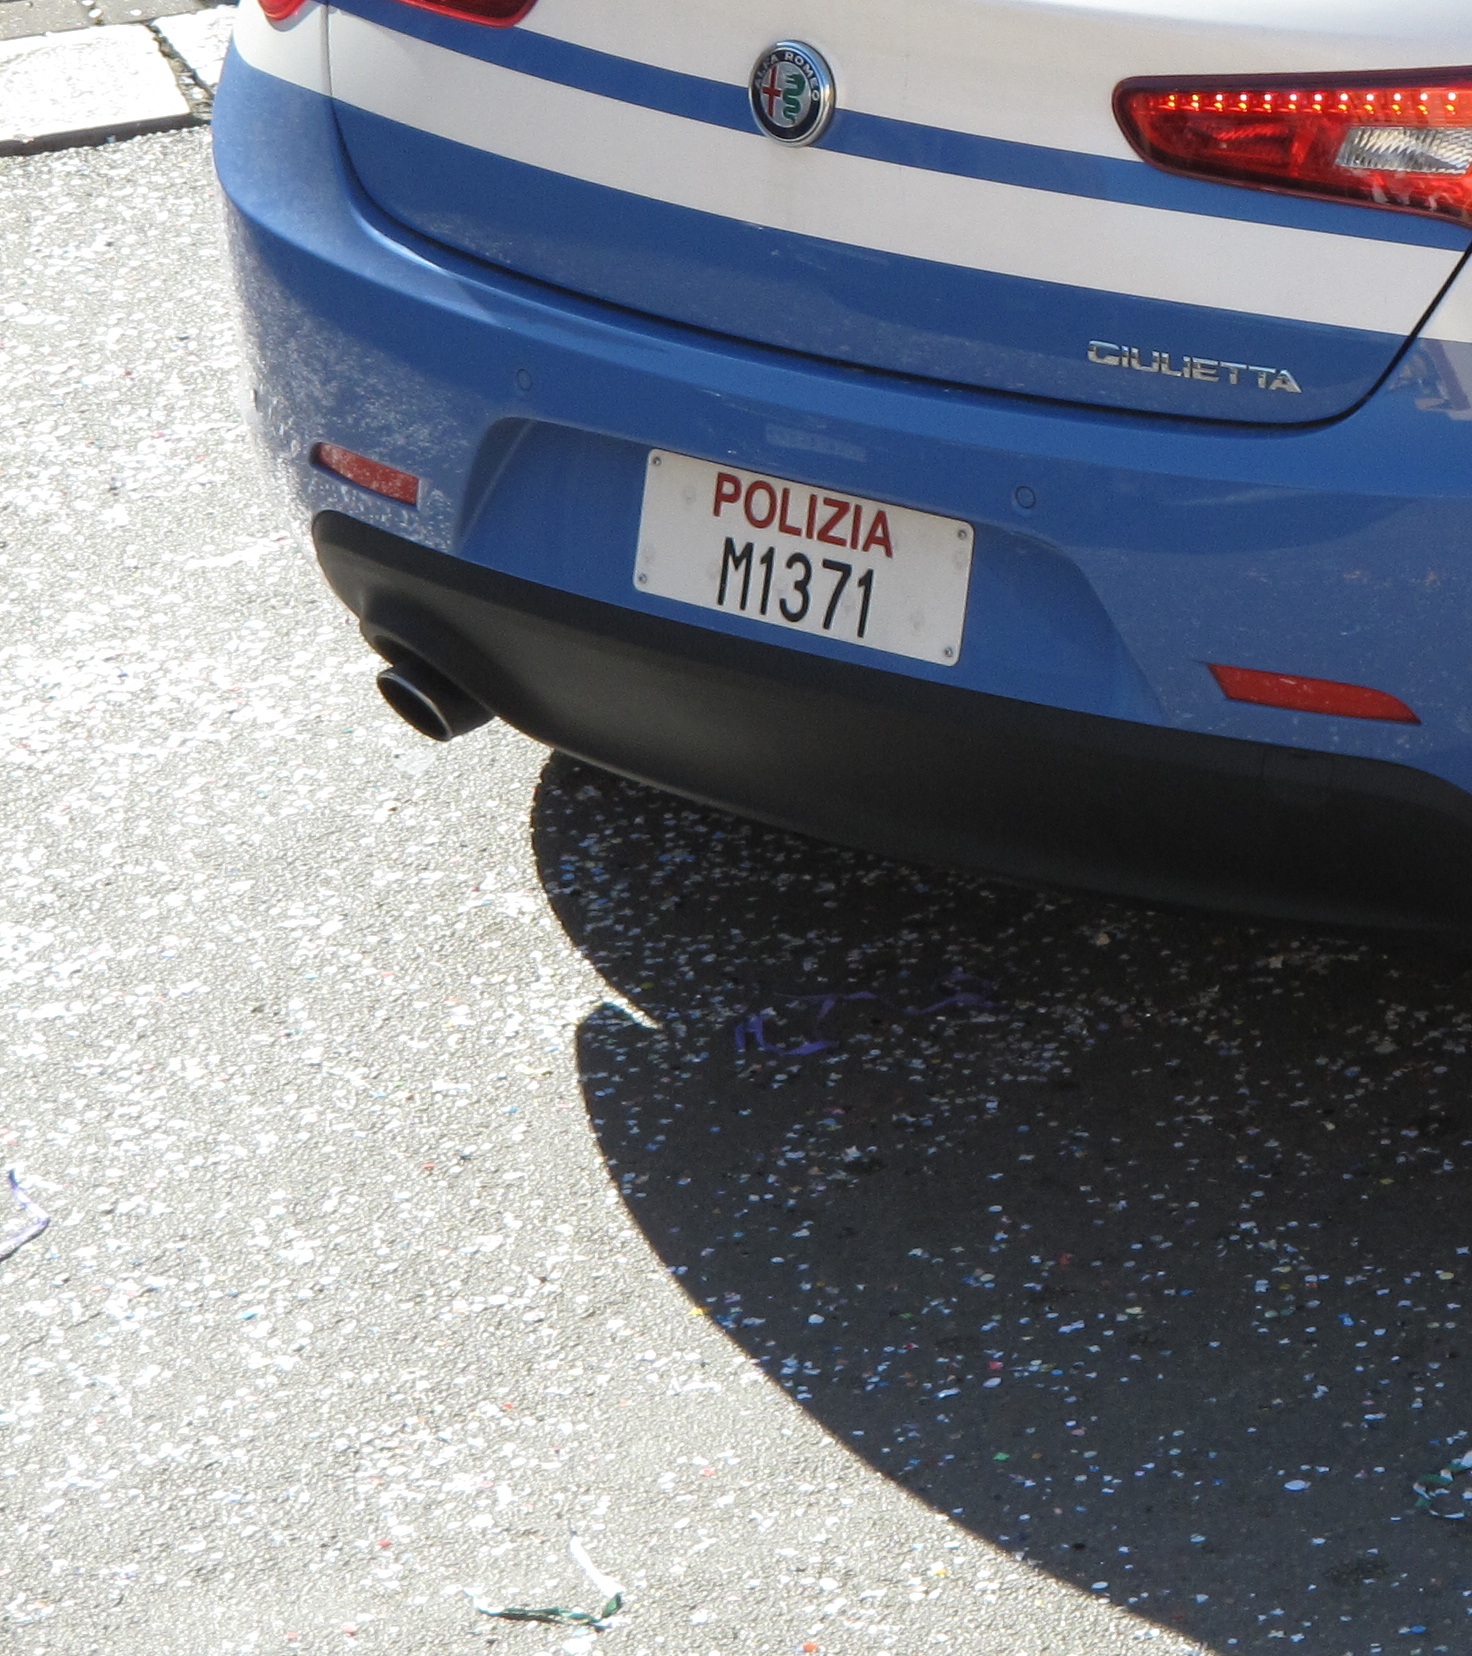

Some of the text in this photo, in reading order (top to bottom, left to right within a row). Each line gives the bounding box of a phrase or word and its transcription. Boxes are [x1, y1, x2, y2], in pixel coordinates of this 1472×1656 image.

[785, 52, 819, 101] ROMEO
[1087, 340, 1302, 393] GIULIETTA
[713, 472, 893, 558] POLIZIA
[717, 537, 874, 638] M1371
